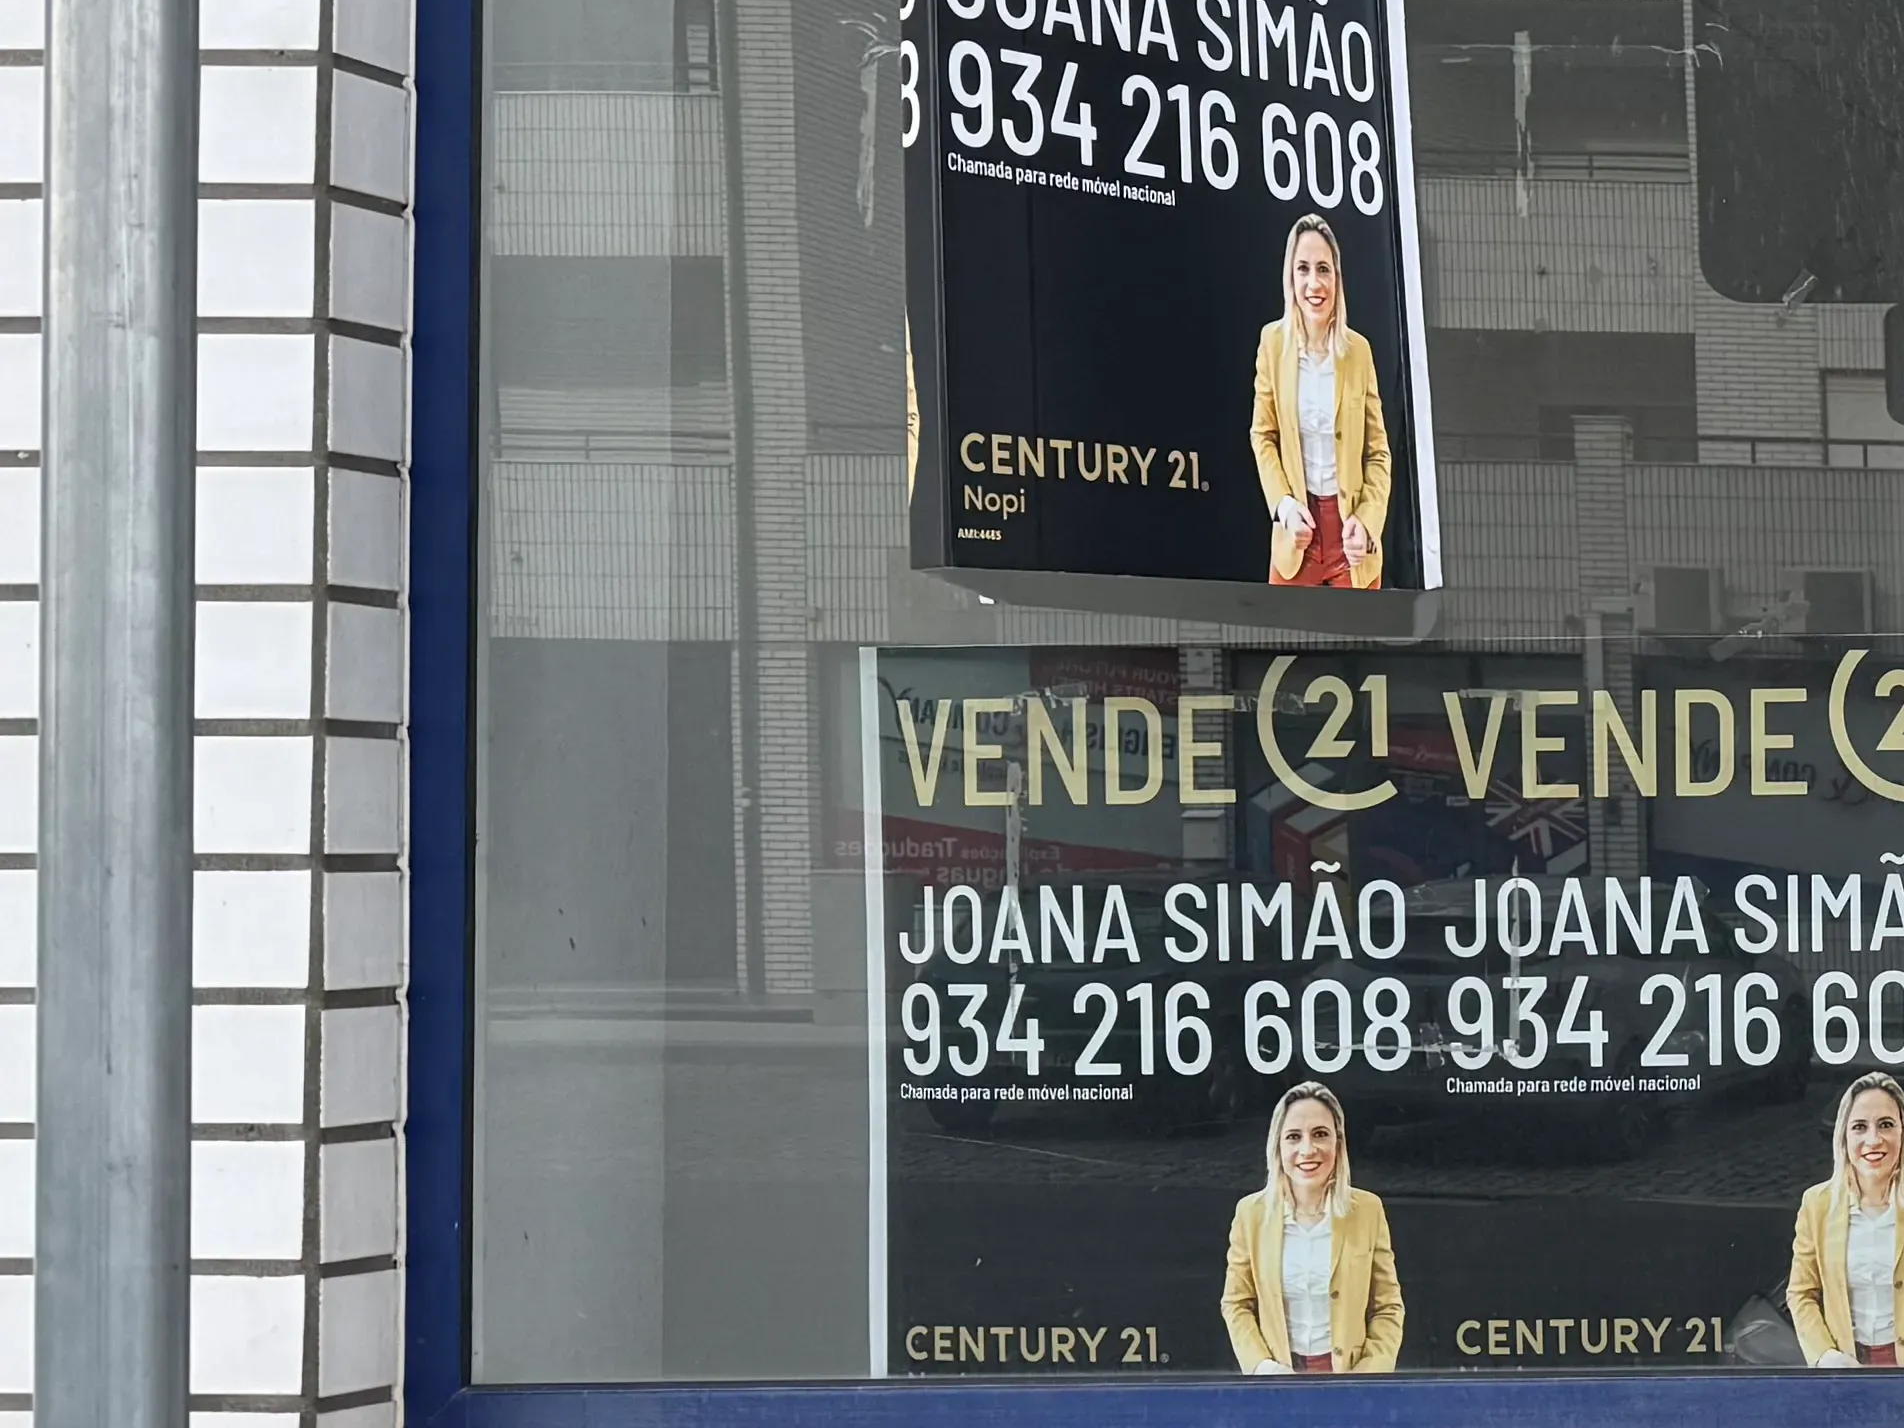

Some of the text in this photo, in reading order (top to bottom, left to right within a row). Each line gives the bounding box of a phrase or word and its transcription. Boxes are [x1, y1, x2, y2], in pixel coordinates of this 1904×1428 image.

[948, 40, 1384, 216] 934 216 608
[947, 151, 1176, 207] Chamada para rede móvel nacional
[960, 432, 1157, 486] CENTURY
[963, 484, 1026, 520] Nopi
[897, 695, 1237, 806] VENDE
[1442, 688, 1808, 800] VENDE
[900, 861, 1406, 964] JOANA SIMÃO
[1444, 875, 1711, 958] JOANA
[902, 977, 1412, 1076] 934 216 608
[1447, 975, 1609, 1070] 934
[1639, 972, 1781, 1067] 216
[900, 1082, 1134, 1103] Chamada para rede móvel nacional
[1447, 1074, 1701, 1096] Chamada para rede móvel nacional
[905, 1325, 1108, 1362] CENTURY
[1456, 1317, 1672, 1355] CENTURY
